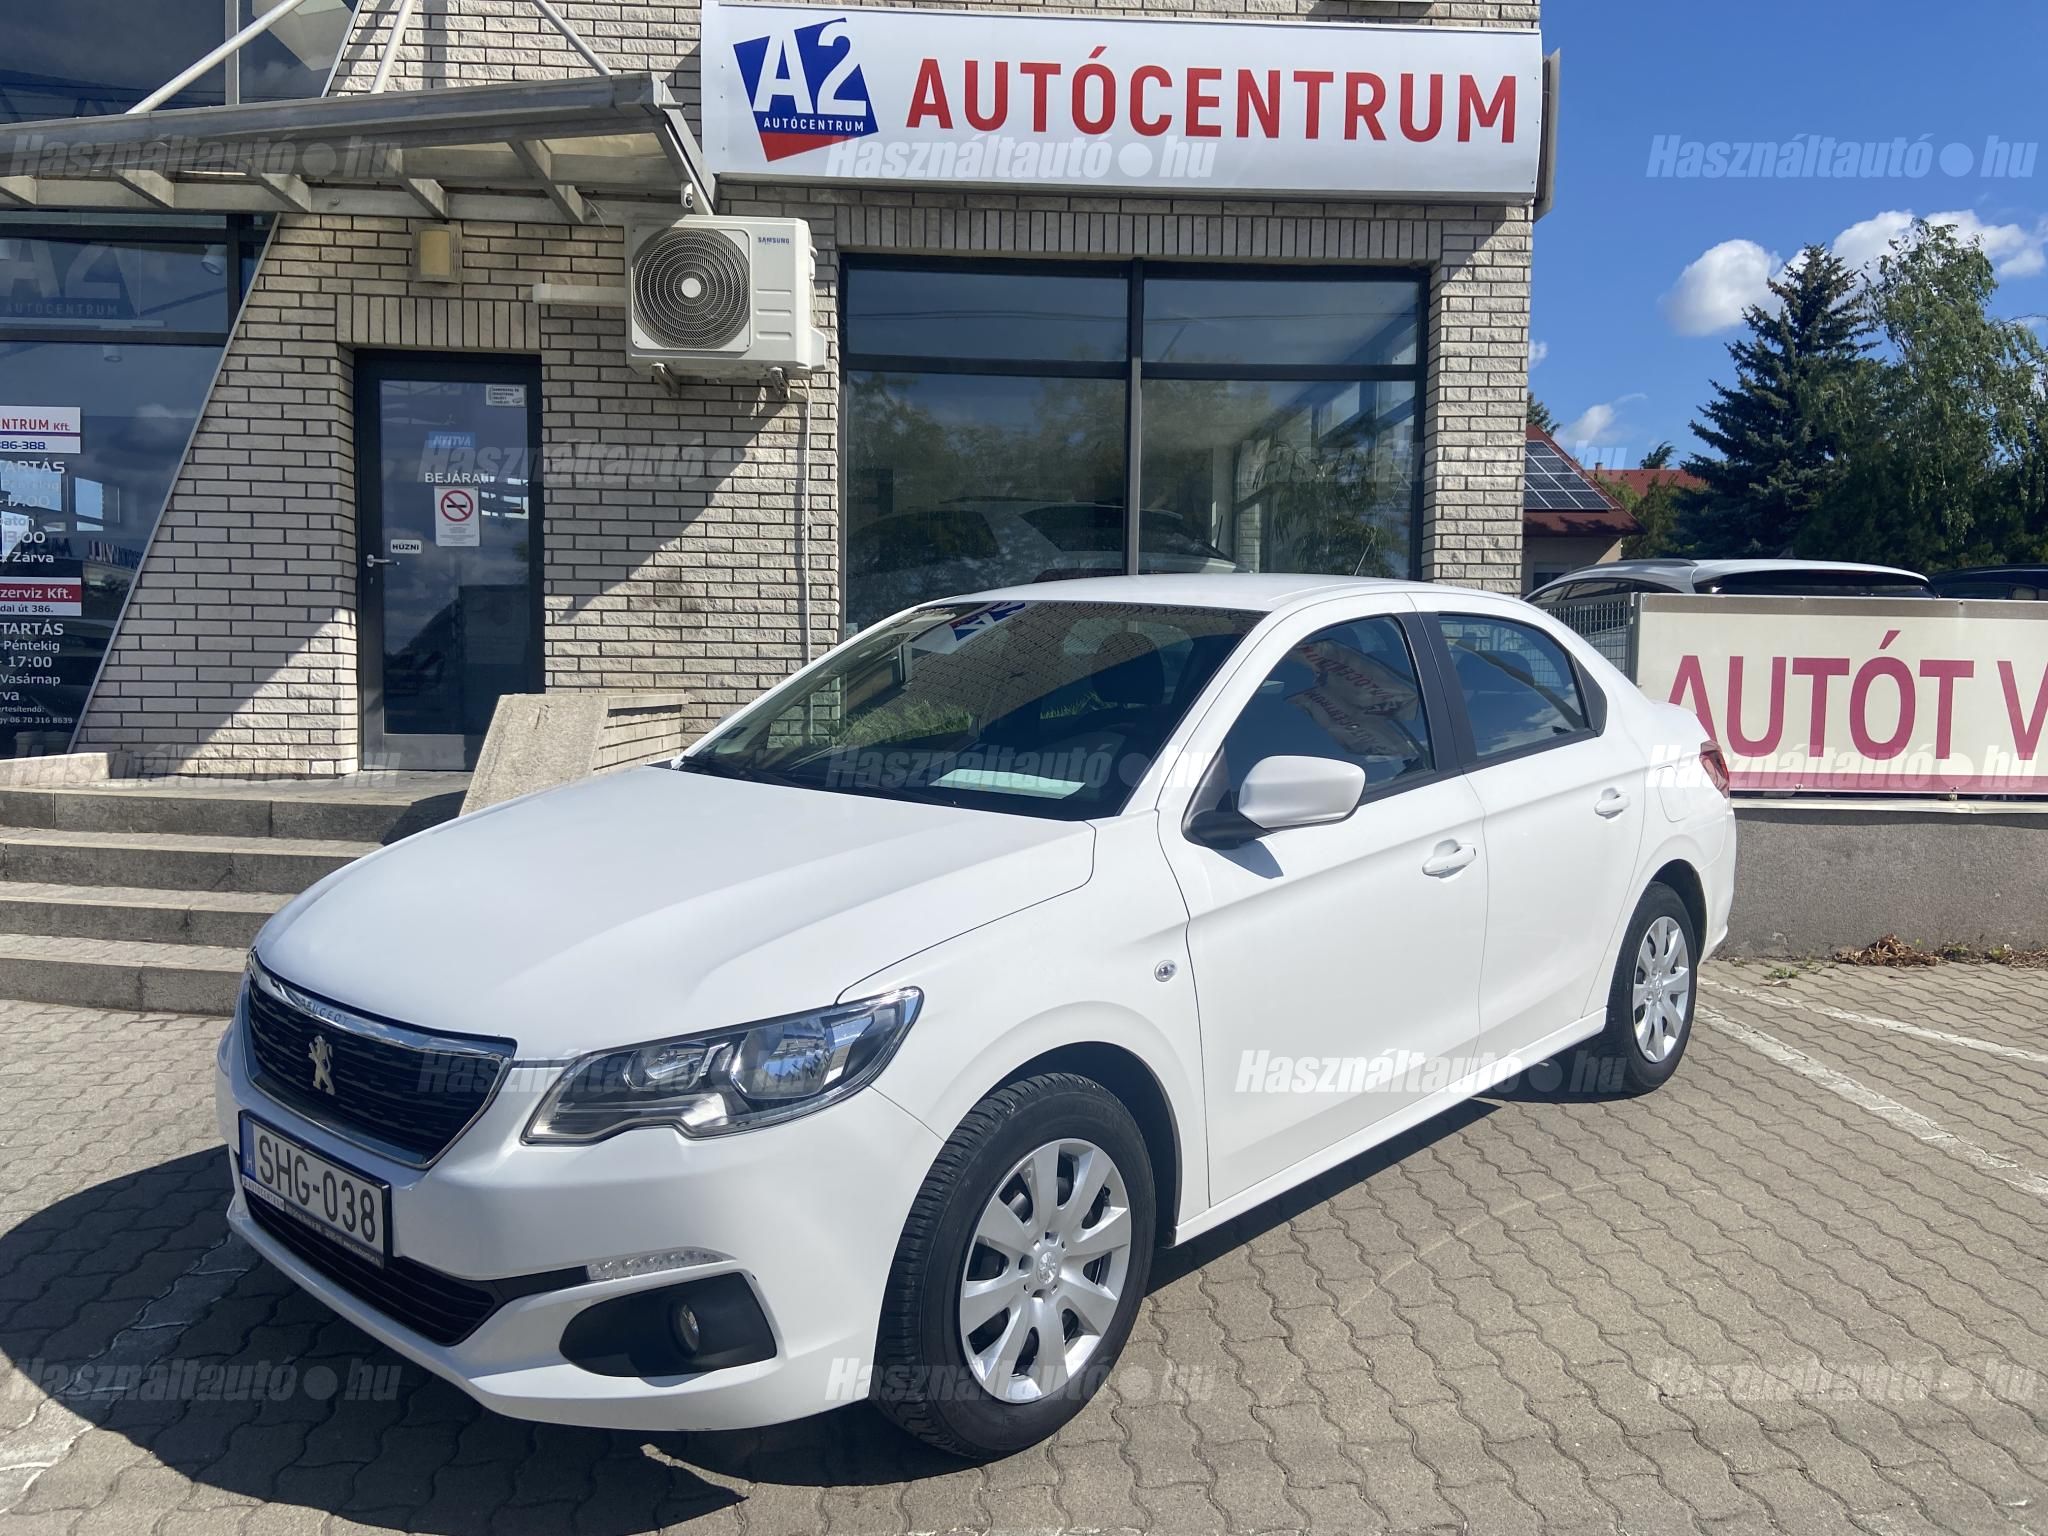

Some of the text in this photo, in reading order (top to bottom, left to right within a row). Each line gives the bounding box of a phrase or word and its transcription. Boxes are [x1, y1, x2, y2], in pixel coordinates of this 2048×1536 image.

[753, 20, 867, 117] A2
[906, 46, 1517, 144] AUTÓCENTRUM
[763, 116, 864, 132] AUTÓCENTRUM
[757, 237, 790, 245] SAMSUNG
[12, 551, 54, 563] Zárva
[47, 588, 73, 599] Kft.
[18, 604, 28, 613] út
[32, 605, 54, 613] 386.
[4, 640, 60, 653] Péntekig
[8, 656, 52, 668] 17:00
[0, 673, 61, 687] Vasárnap
[1667, 630, 1975, 761] AUTÓT
[259, 1135, 376, 1243] SHG-038
